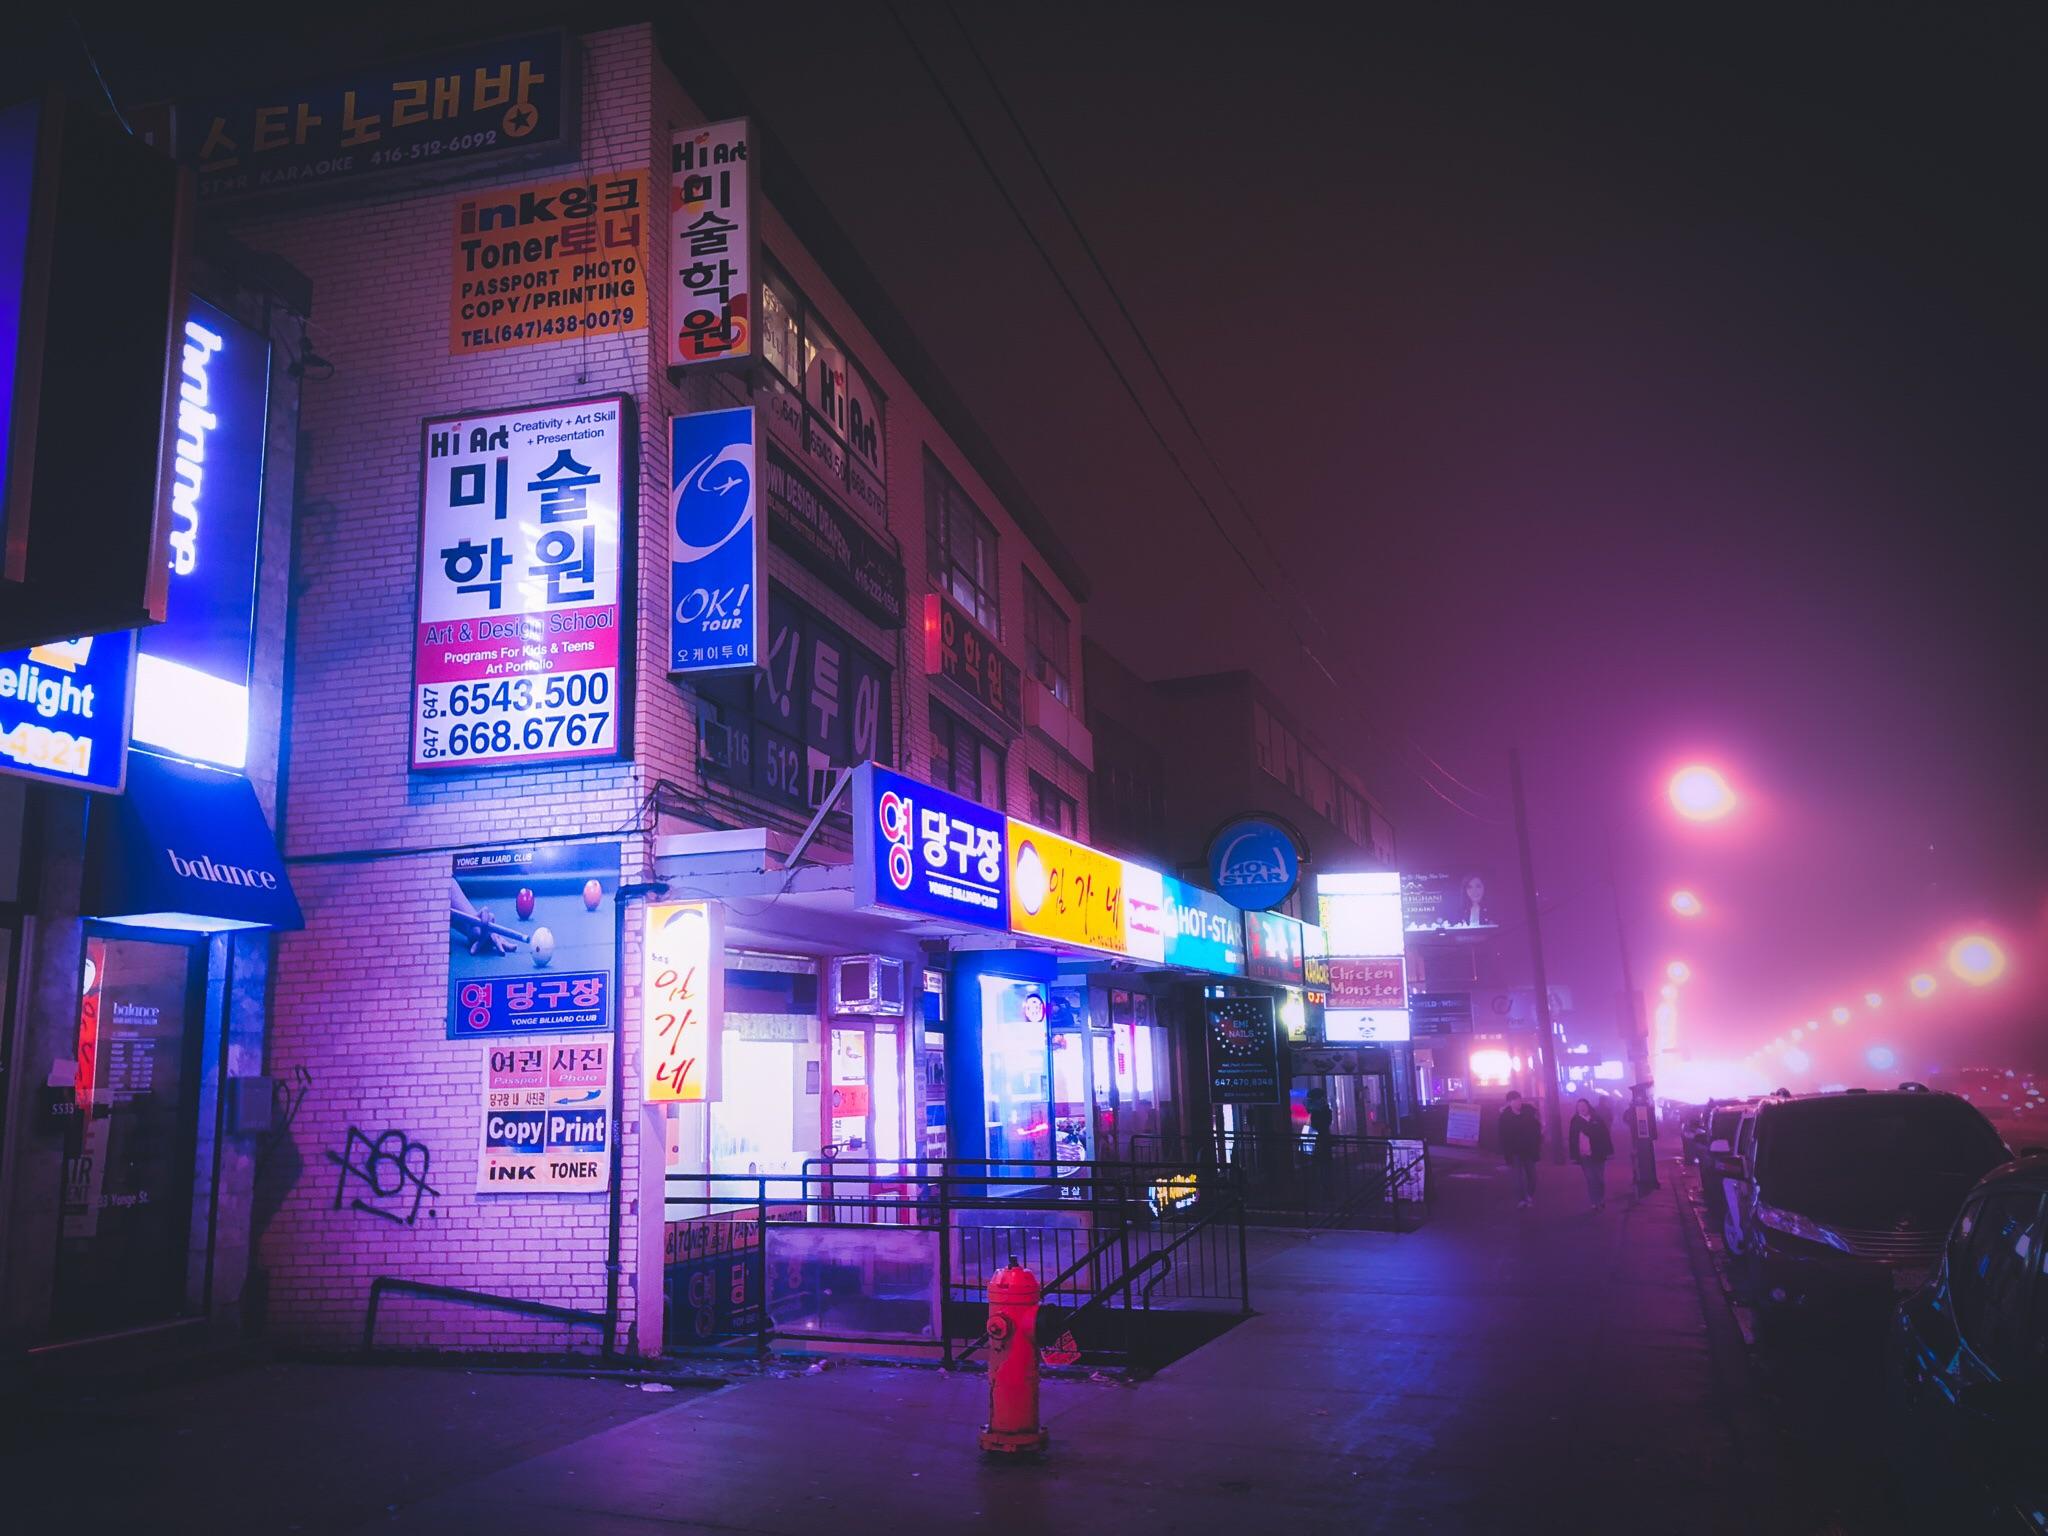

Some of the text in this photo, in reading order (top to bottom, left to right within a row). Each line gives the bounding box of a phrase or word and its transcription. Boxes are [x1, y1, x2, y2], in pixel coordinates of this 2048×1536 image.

[199, 60, 545, 172] 스타 노래방
[259, 155, 353, 186] KARAOKE
[370, 129, 498, 166] 416-512-6092
[672, 134, 748, 172] Hi Art
[462, 257, 636, 299] PASSPORT PHOTO
[461, 279, 636, 320] COPY/PRINTING
[513, 416, 563, 434] Creativity
[575, 412, 592, 426] Art
[593, 410, 617, 424] Skill
[536, 428, 605, 447] Presentation
[431, 424, 509, 459] Hi Art
[675, 583, 750, 625] OK!
[425, 608, 614, 645] Art & Design School
[701, 617, 743, 632] TOUR
[444, 640, 595, 665] Programs For Kids & Teens
[485, 657, 553, 675] Art Portfolio
[942, 611, 1004, 711] 유학원
[0, 663, 94, 718] elight
[423, 687, 439, 719] 647
[423, 728, 439, 760] 647
[767, 739, 799, 797] 512
[879, 789, 1002, 891] 영 당구장
[166, 848, 278, 890] balance
[457, 852, 533, 867] YONGE BILLIARD CLUB
[1229, 861, 1273, 874] HOT
[1222, 872, 1284, 885] STAR
[1178, 904, 1243, 947] HOT-STAR
[1329, 966, 1394, 981] Chicken
[1331, 981, 1401, 996] Monster
[461, 977, 603, 1029] 영 당구장
[511, 1014, 597, 1026] YONGE BILLIARD CLUB
[1228, 1029, 1255, 1038] NAILS
[491, 1047, 603, 1074] 여권 사진
[494, 1073, 598, 1088] Passport Photo
[488, 1115, 604, 1144] Copy Print
[549, 1161, 598, 1179] TONER
